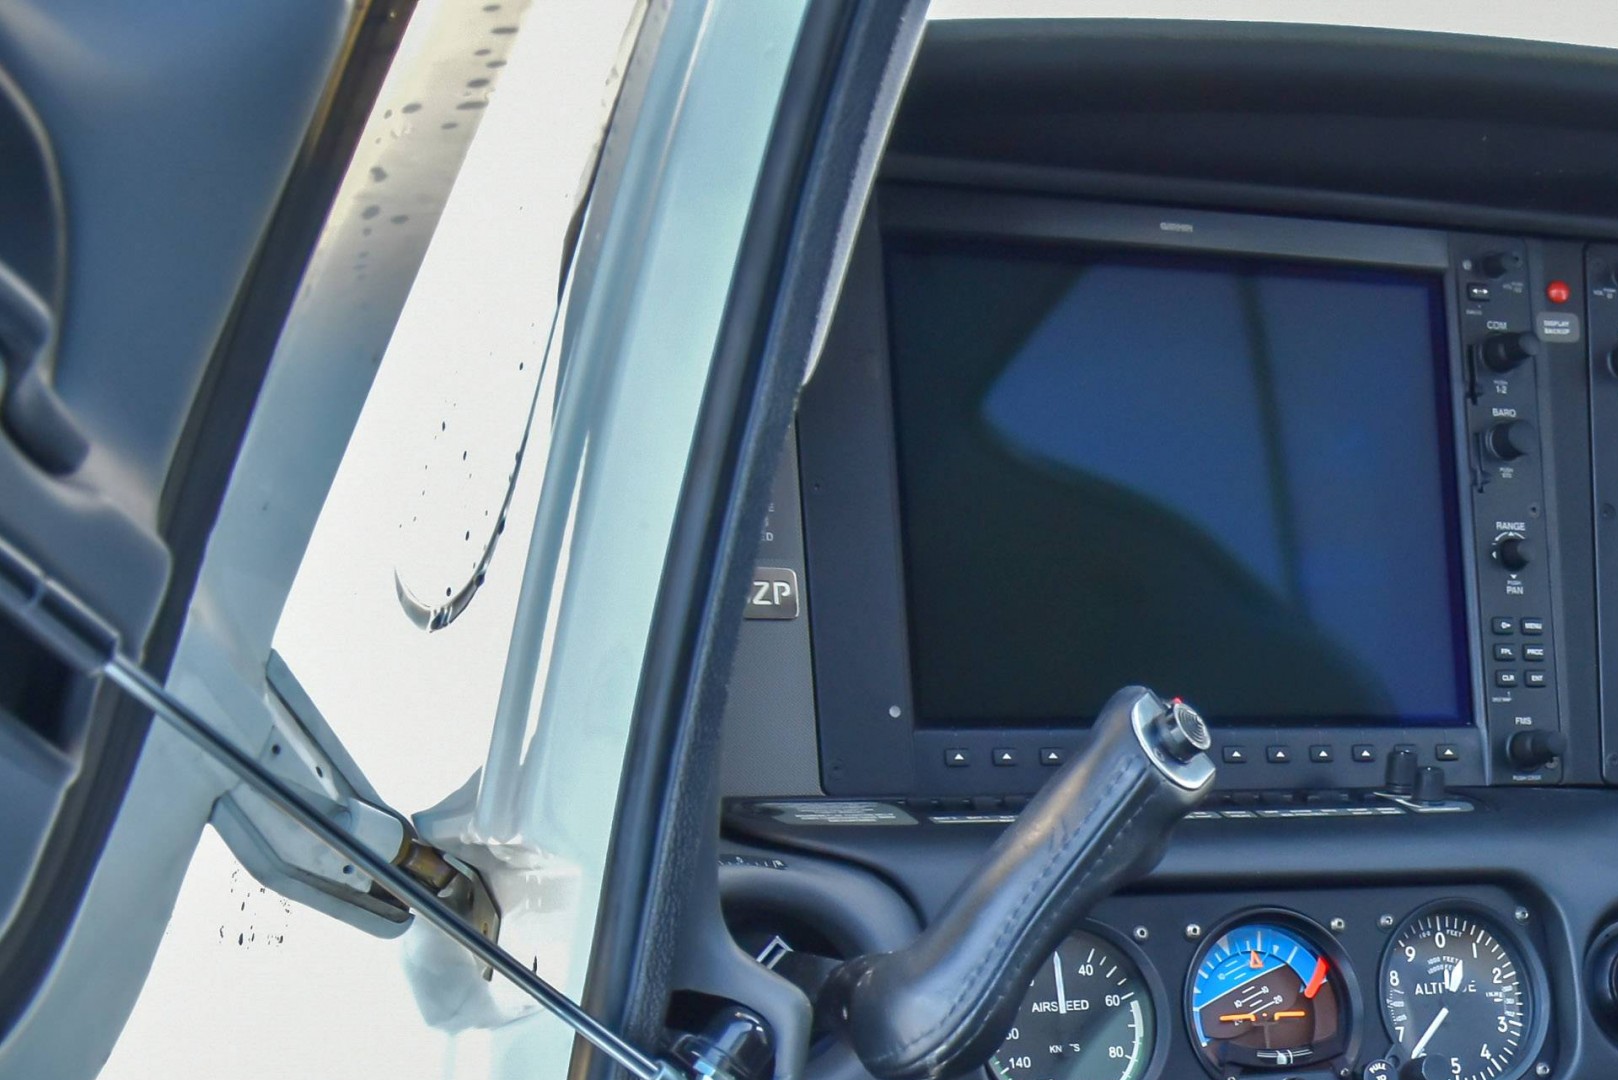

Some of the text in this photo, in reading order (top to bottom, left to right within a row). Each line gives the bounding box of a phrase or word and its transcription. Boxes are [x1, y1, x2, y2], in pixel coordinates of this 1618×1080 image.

[1487, 321, 1507, 330] COM
[1492, 408, 1516, 417] BARO
[1496, 522, 1525, 531] RANGE
[747, 581, 791, 605] ZP
[1506, 586, 1523, 595] PAN
[1515, 717, 1532, 725] FMS
[1446, 929, 1462, 937] FEET
[1435, 932, 1445, 948] 0
[1405, 946, 1415, 962] 9
[1078, 964, 1093, 976] 40
[1390, 967, 1502, 986] 8 2
[1415, 980, 1476, 995] ALTIE
[1032, 1000, 1089, 1013] AIRSEED
[1105, 995, 1120, 1007] 60
[1497, 1016, 1508, 1032] 3
[1395, 1026, 1405, 1043] 7
[1049, 1043, 1080, 1053] KNS
[1109, 1046, 1123, 1057] 80
[1480, 1043, 1491, 1059] 4
[1009, 1057, 1031, 1068] 140
[1369, 1063, 1386, 1073] PULL
[1451, 1058, 1461, 1074] 5
